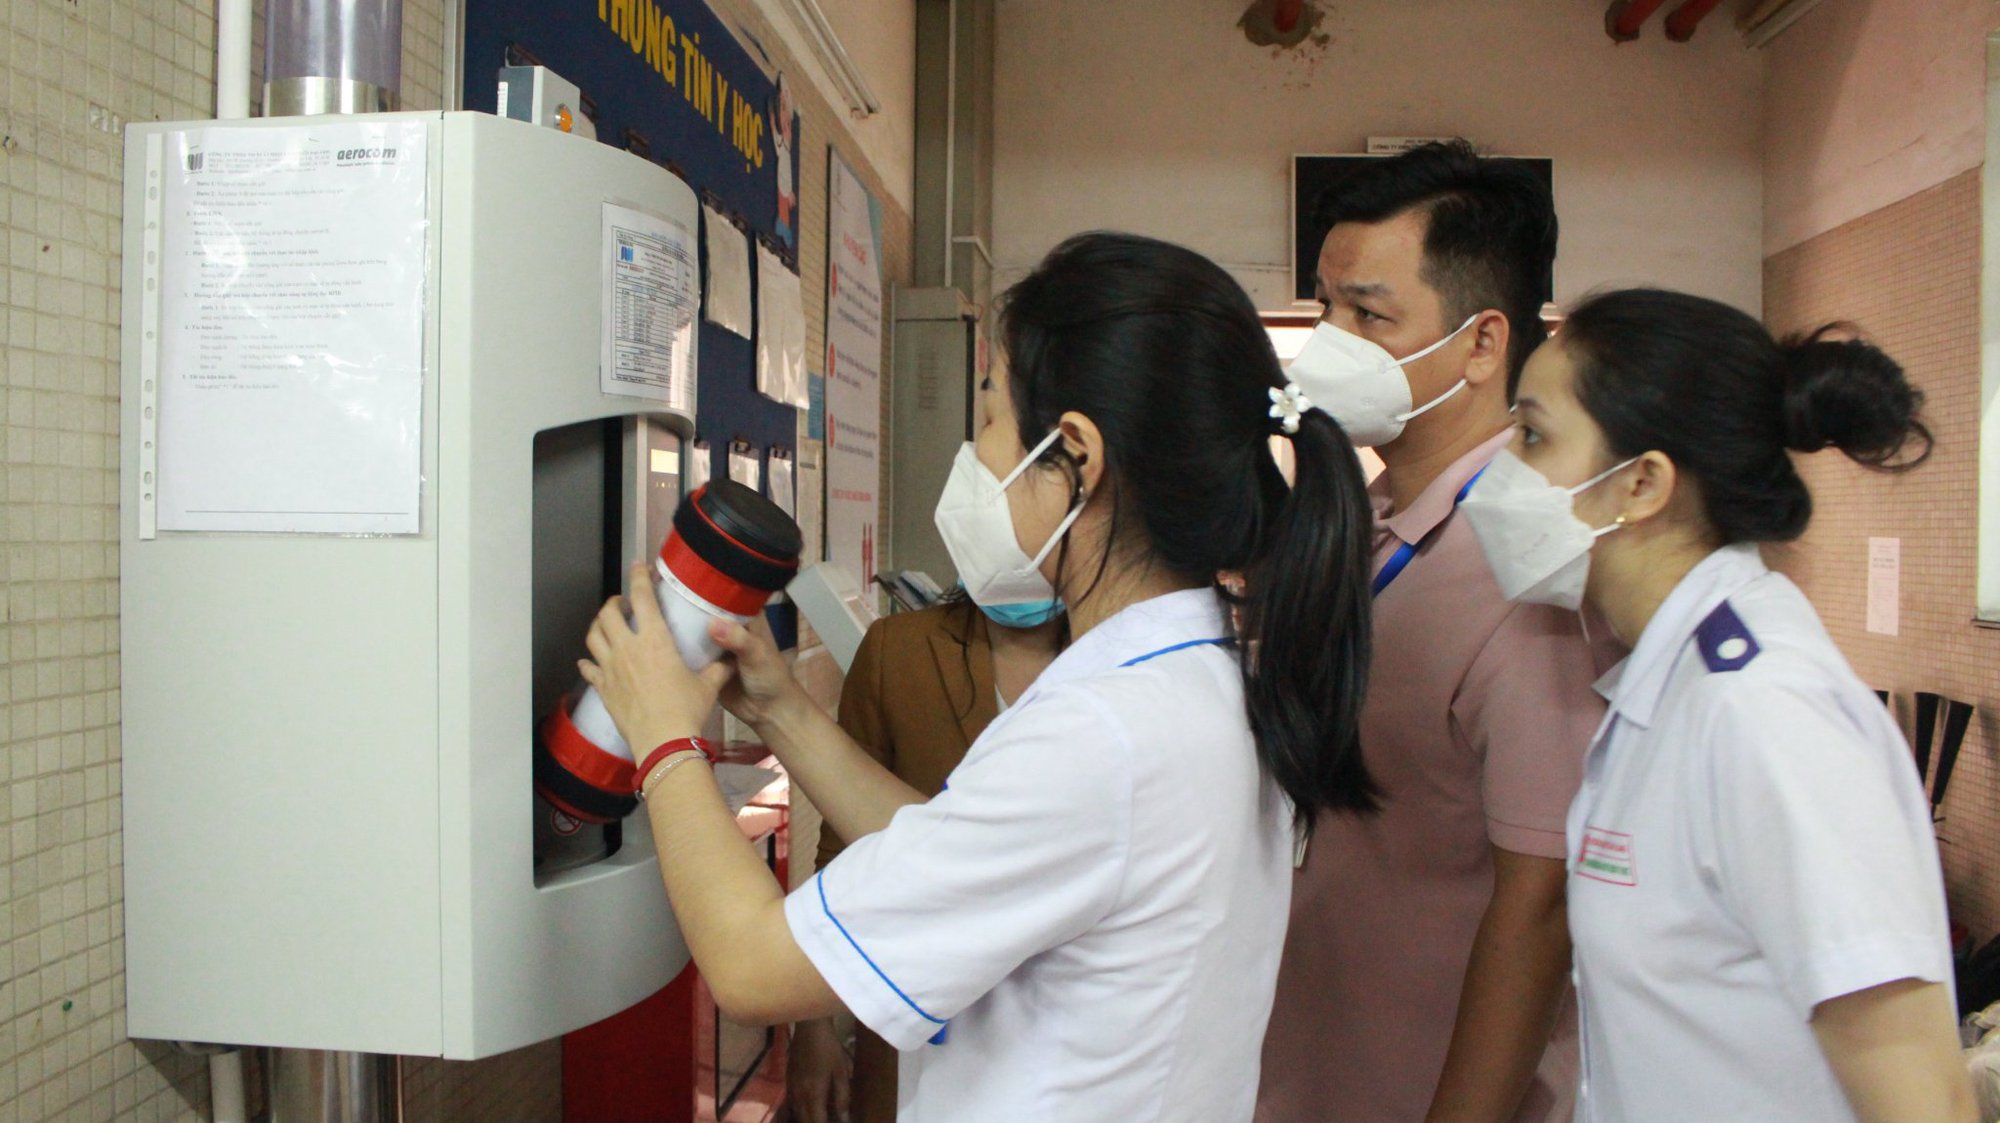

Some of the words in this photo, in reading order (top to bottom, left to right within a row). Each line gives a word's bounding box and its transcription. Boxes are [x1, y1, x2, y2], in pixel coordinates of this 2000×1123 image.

[717, 72, 728, 135] Y
[733, 89, 763, 173] HỌC
[337, 148, 397, 160] aerocom
